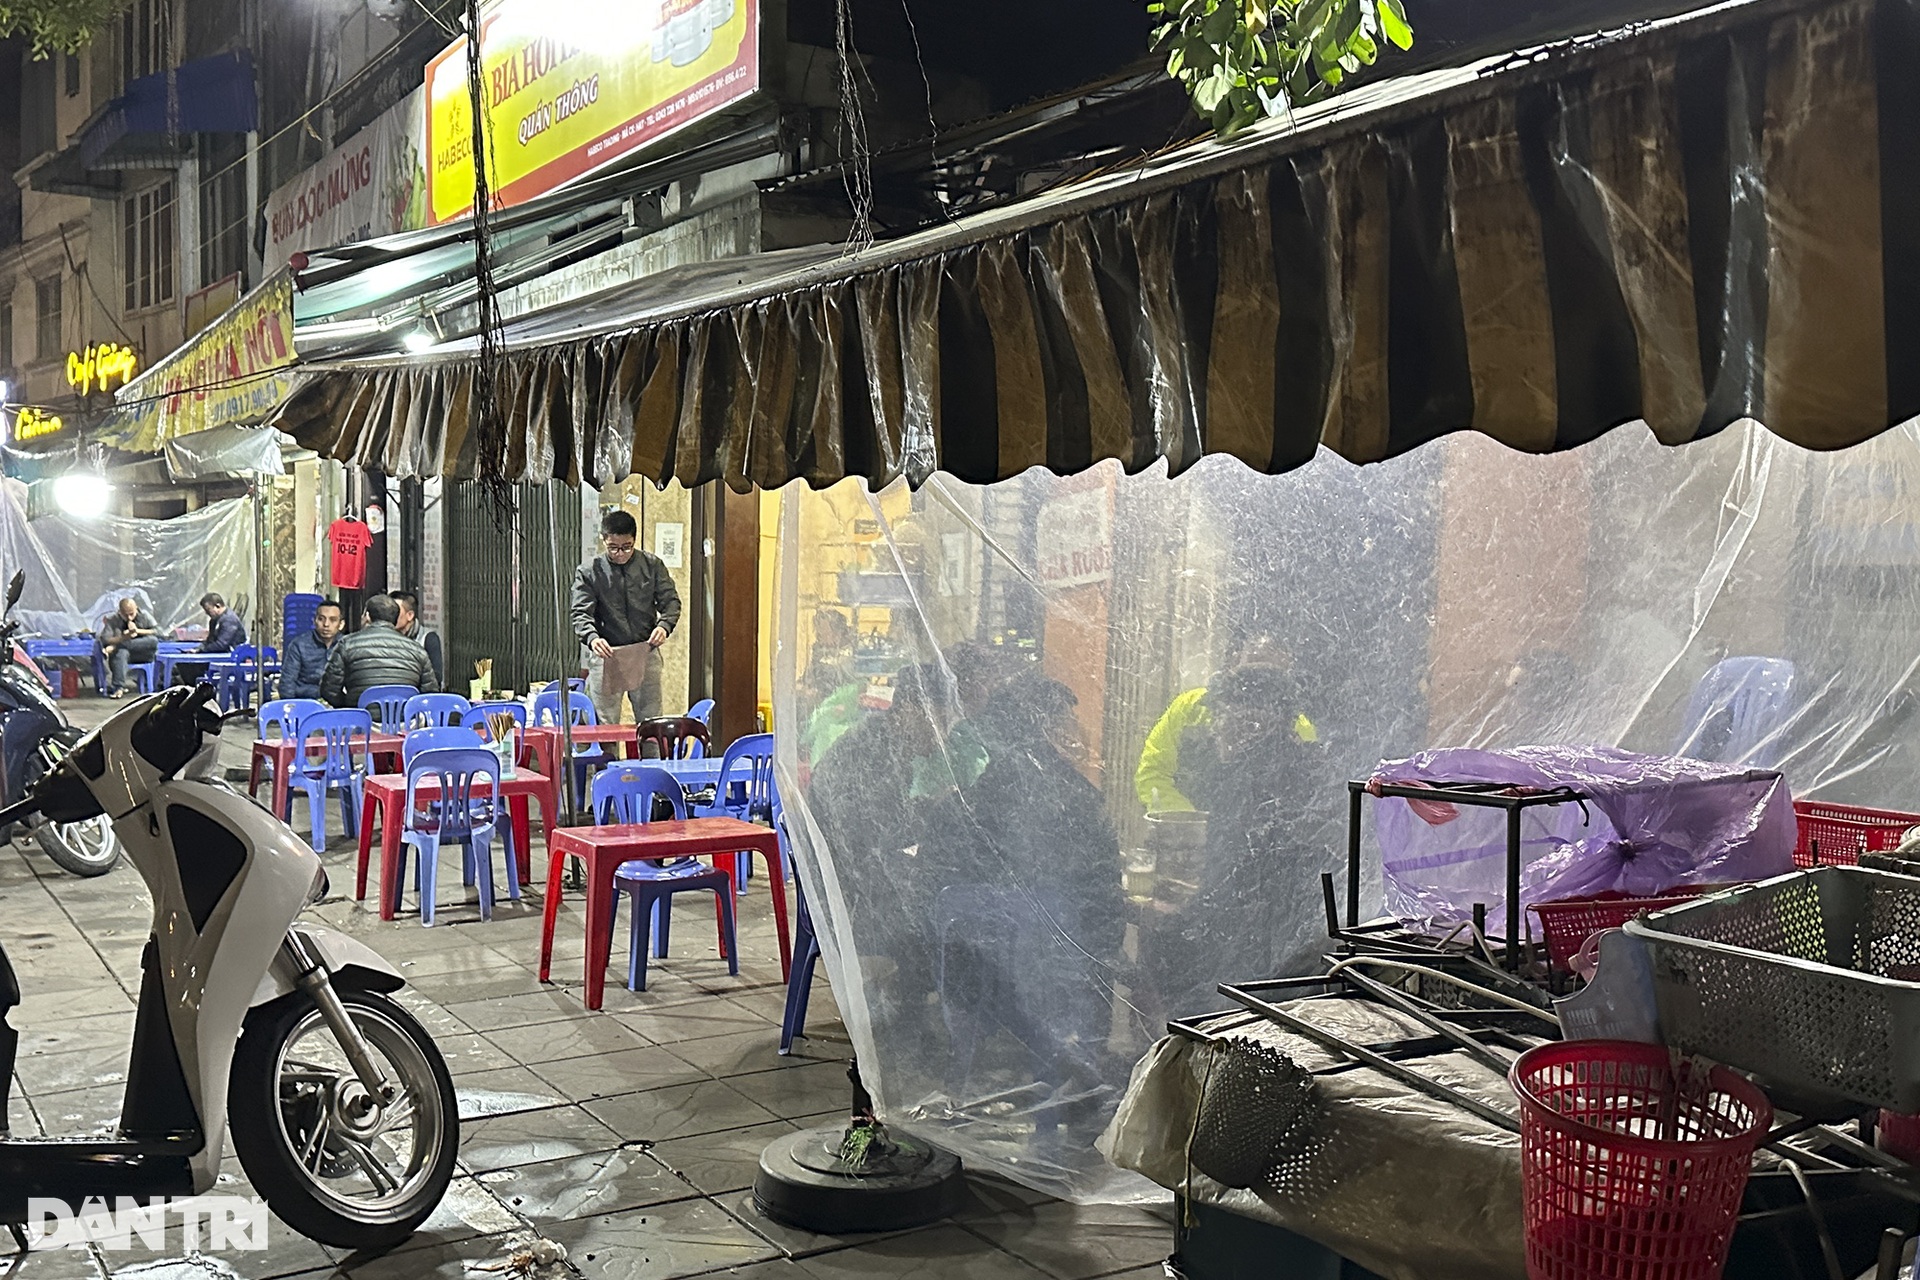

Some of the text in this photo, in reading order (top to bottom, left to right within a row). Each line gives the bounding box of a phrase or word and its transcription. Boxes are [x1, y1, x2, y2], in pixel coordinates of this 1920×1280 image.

[491, 54, 521, 109] BIA
[518, 73, 599, 147] QUÁN THÔNG
